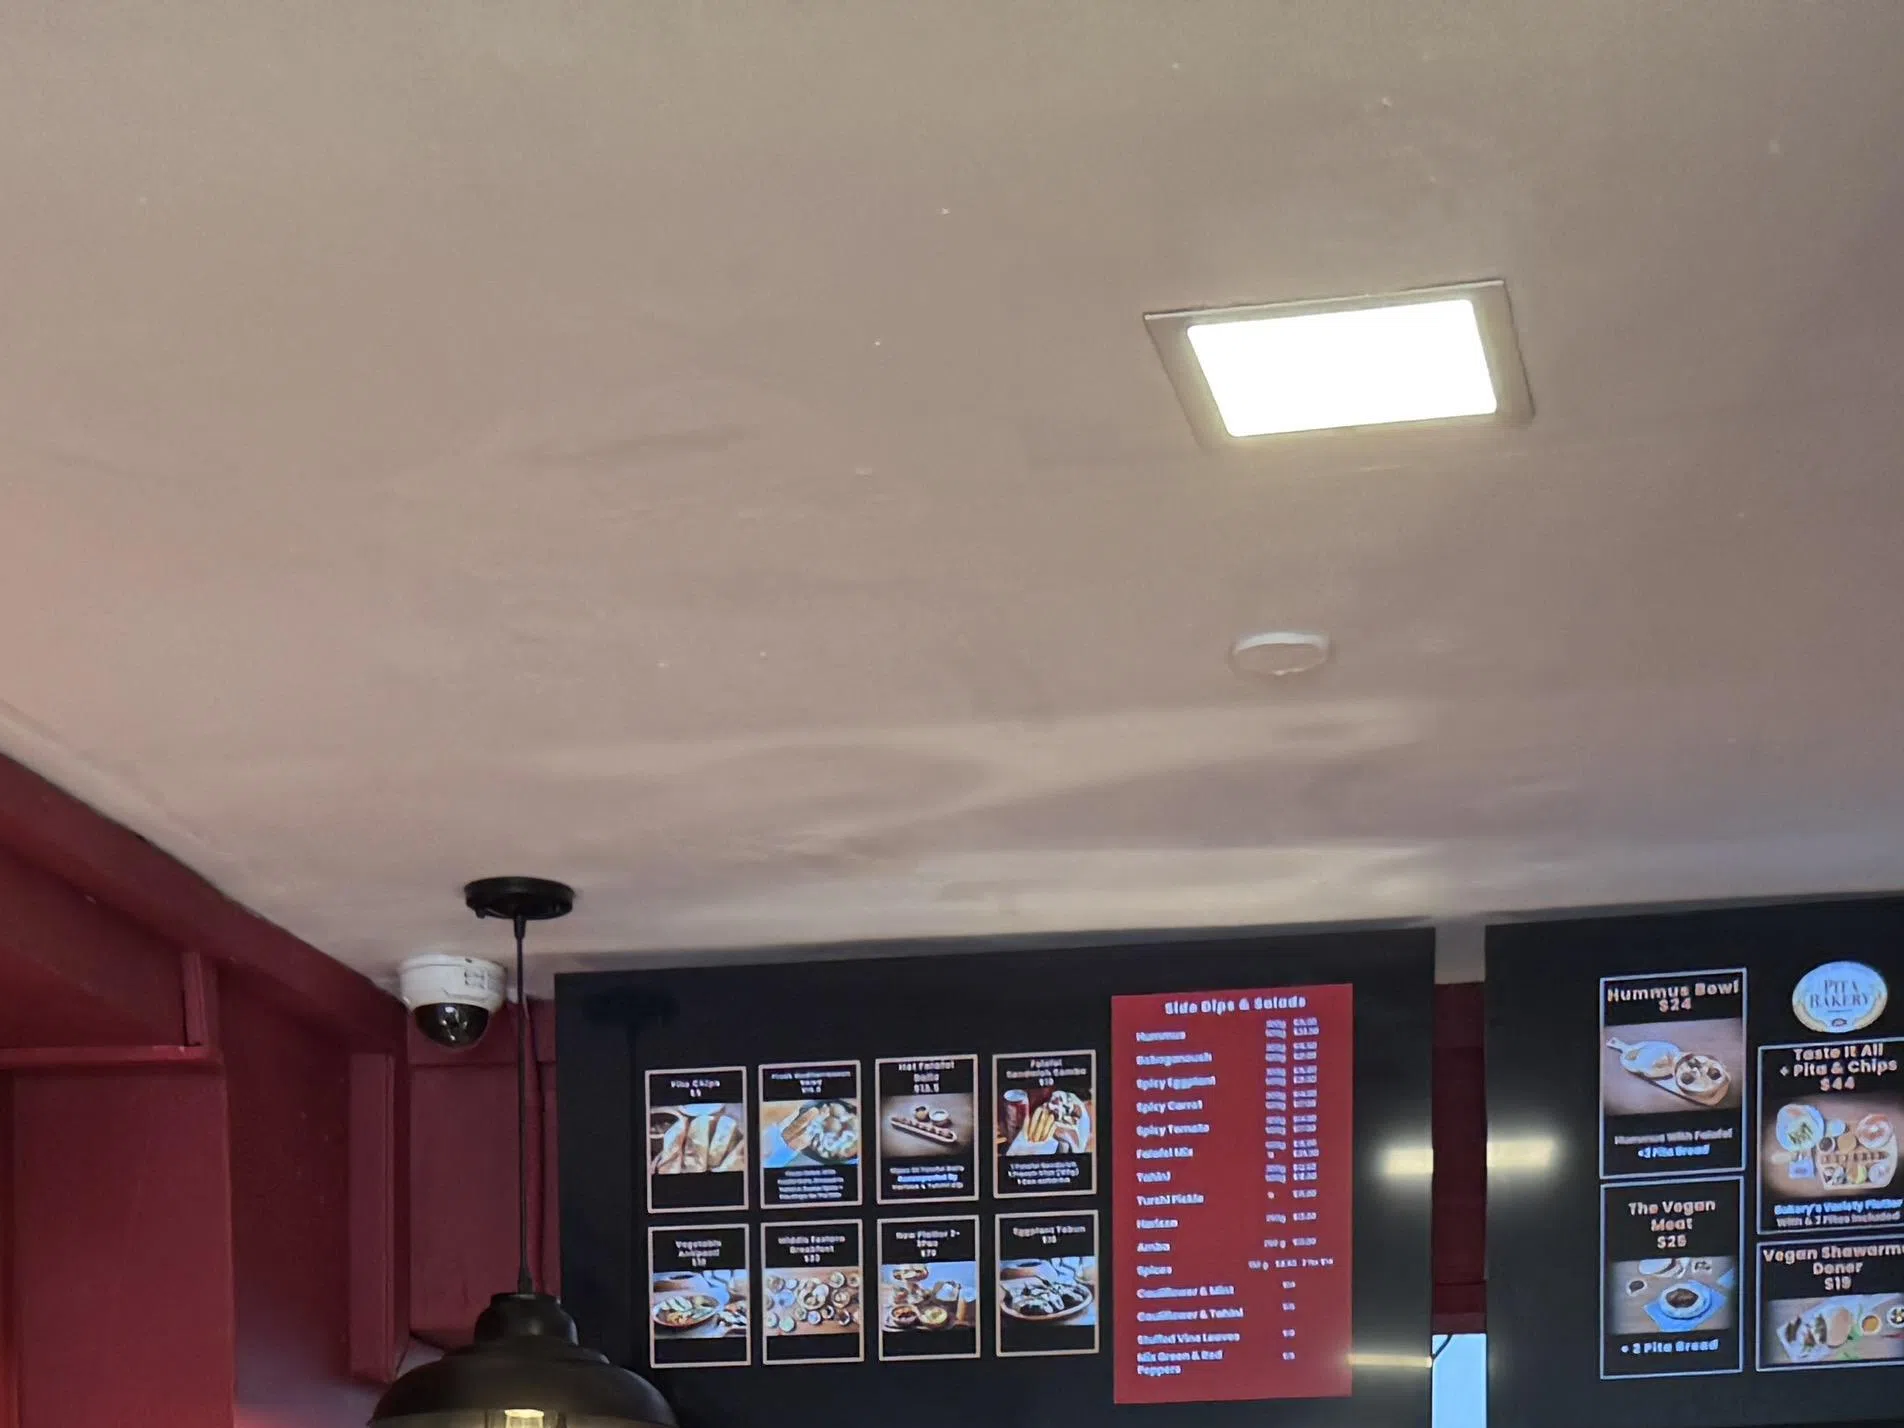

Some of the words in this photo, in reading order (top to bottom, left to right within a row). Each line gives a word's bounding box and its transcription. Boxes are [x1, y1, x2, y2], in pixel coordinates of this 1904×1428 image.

[1607, 986, 1690, 1002] Hummus
[1695, 980, 1740, 996] Bowl
[1824, 979, 1859, 994] PITA
[1659, 997, 1692, 1013] $24
[1810, 993, 1870, 1009] BAKERY
[1793, 1046, 1841, 1061] Taste
[1844, 1045, 1857, 1058] It
[1861, 1043, 1884, 1057] All
[1793, 1062, 1828, 1077] Pita
[1848, 1058, 1898, 1076] Chips
[1628, 1201, 1658, 1216] The
[1662, 1200, 1716, 1215] Vegan
[1651, 1218, 1693, 1232] Meat
[1763, 1248, 1818, 1264] Vegan
